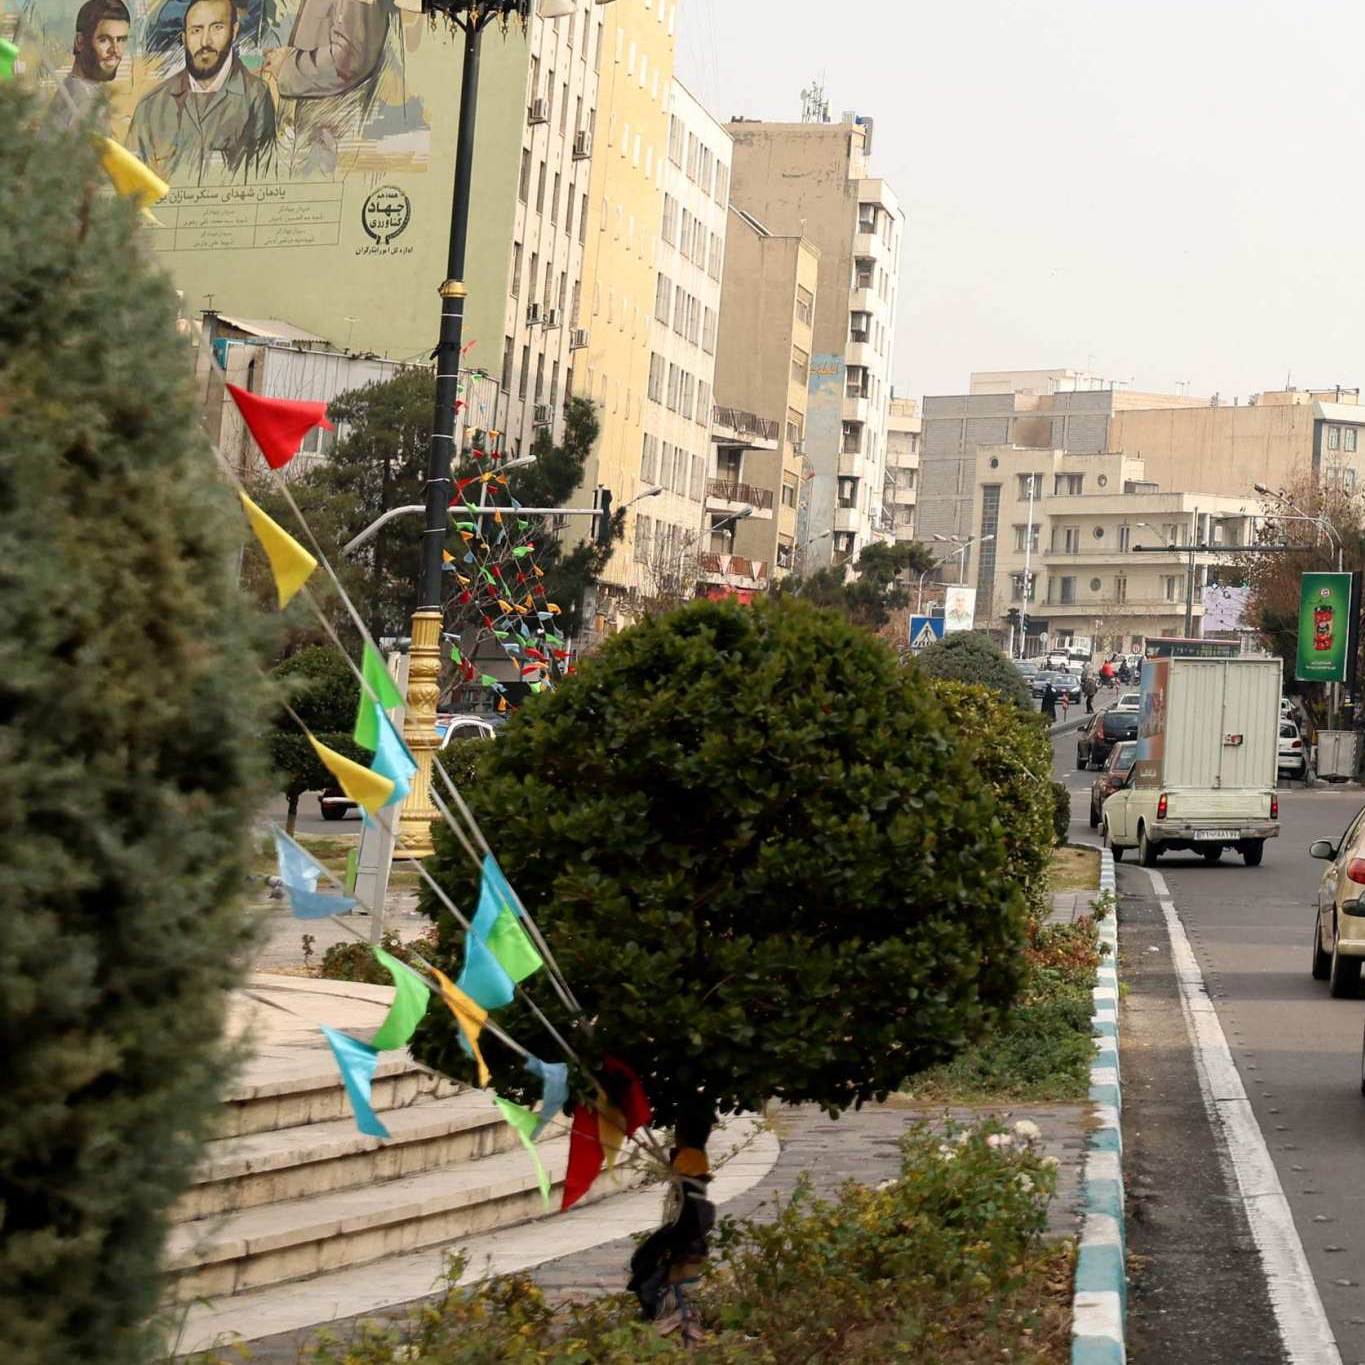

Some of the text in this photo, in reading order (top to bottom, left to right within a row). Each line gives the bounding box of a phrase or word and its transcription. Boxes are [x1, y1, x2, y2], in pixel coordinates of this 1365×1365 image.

[221, 188, 255, 202] شهدای
[368, 202, 404, 216] جهاد
[370, 217, 402, 228] کشاورزی
